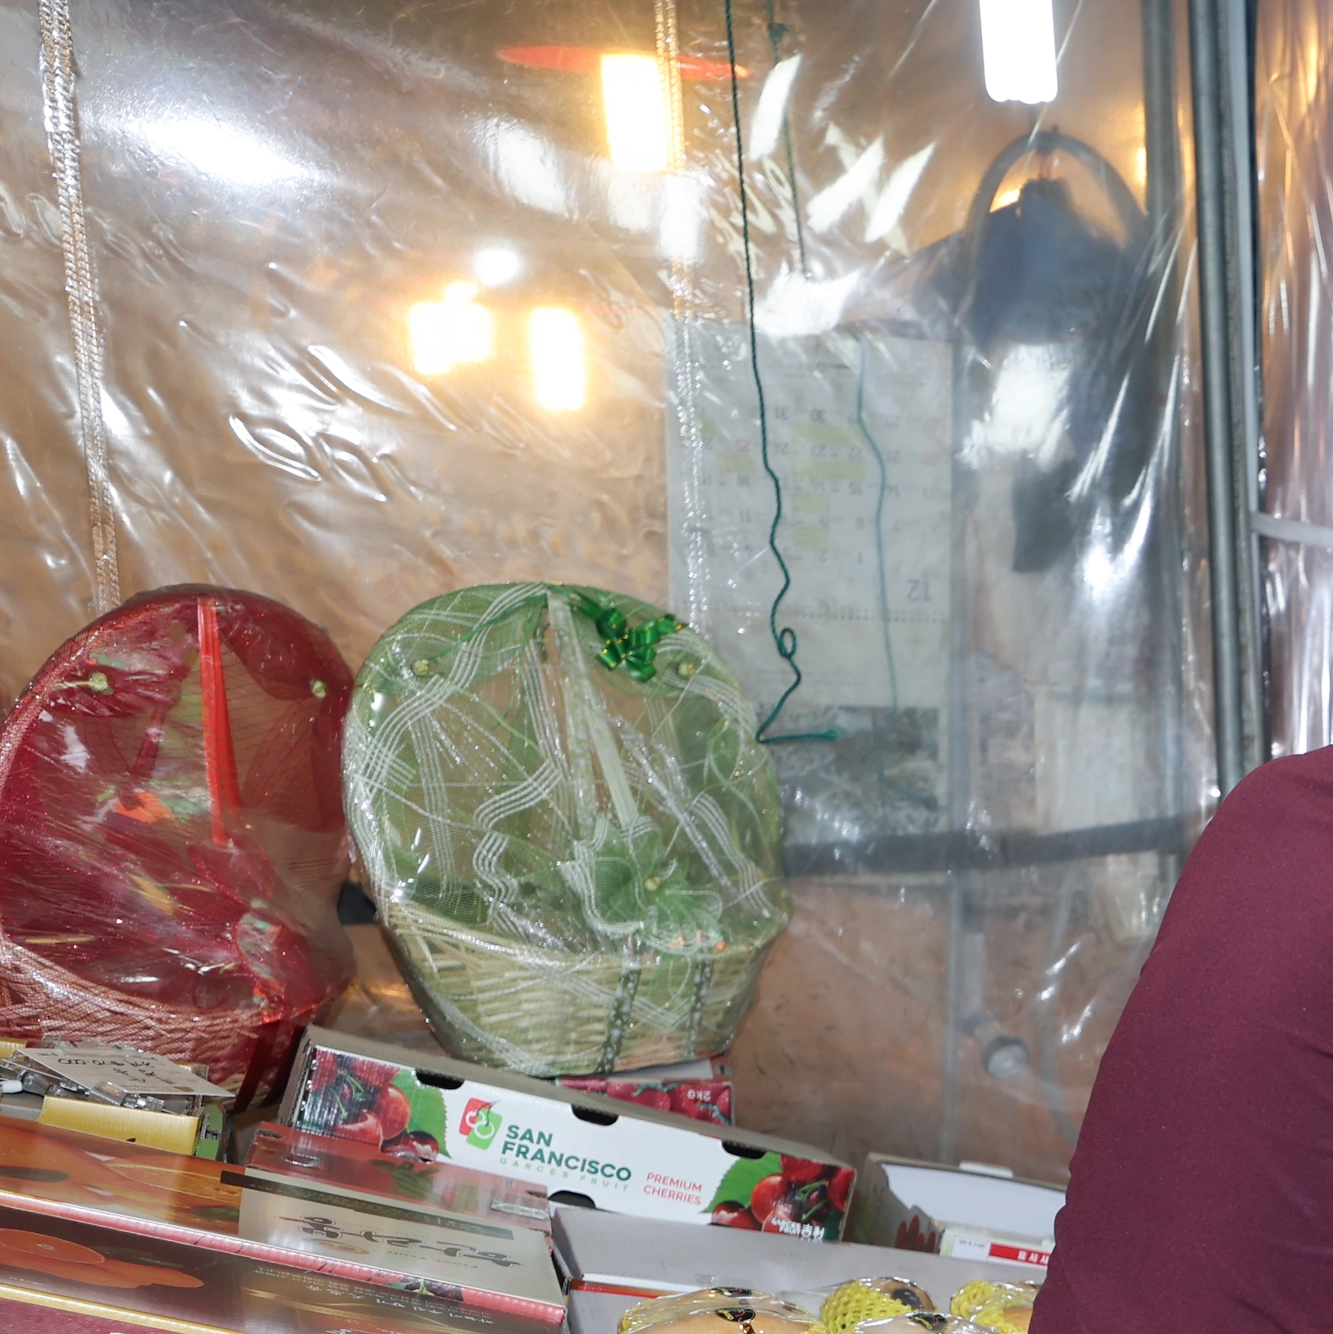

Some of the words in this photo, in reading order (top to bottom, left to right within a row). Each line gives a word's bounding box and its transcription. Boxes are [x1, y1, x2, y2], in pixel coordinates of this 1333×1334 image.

[907, 579, 932, 603] 12
[505, 1124, 553, 1148] SAN
[501, 1141, 632, 1182] FRANCISCO
[500, 1157, 569, 1181] GARCES
[579, 1175, 630, 1193] FRUIT
[646, 1172, 703, 1194] PREMIUM
[643, 1184, 703, 1206] CHERRIES
